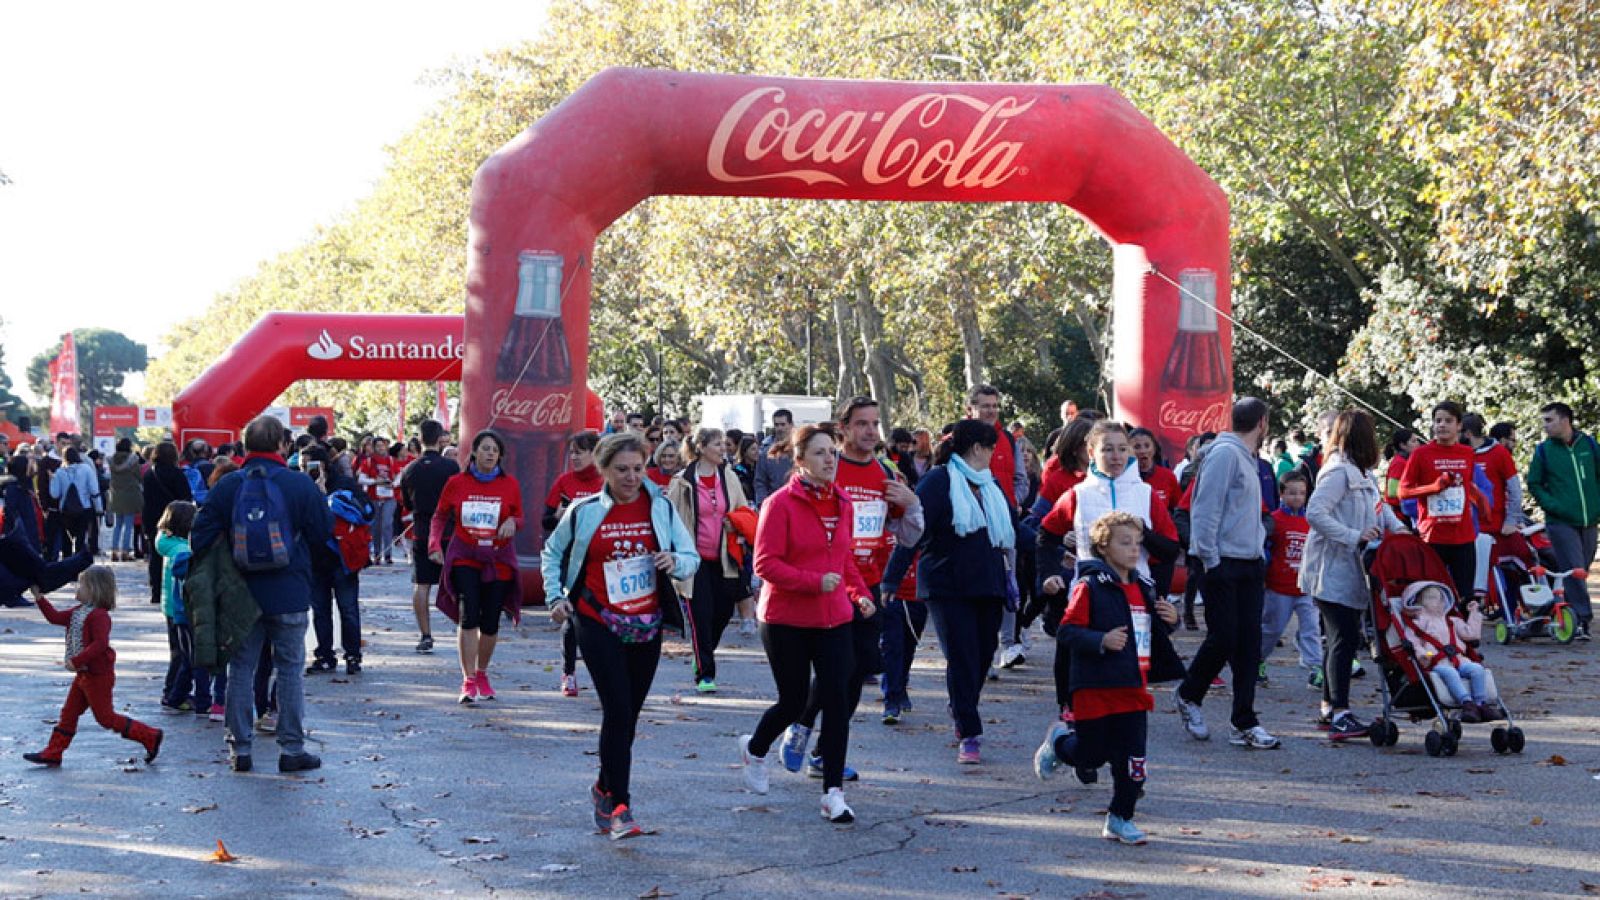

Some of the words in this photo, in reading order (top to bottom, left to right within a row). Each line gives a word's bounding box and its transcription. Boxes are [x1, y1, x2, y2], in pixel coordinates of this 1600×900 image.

[706, 86, 1038, 189] Coca-Cola
[349, 333, 464, 360] Santande
[491, 388, 573, 426] Coca-Cola
[620, 570, 652, 594] 6702
